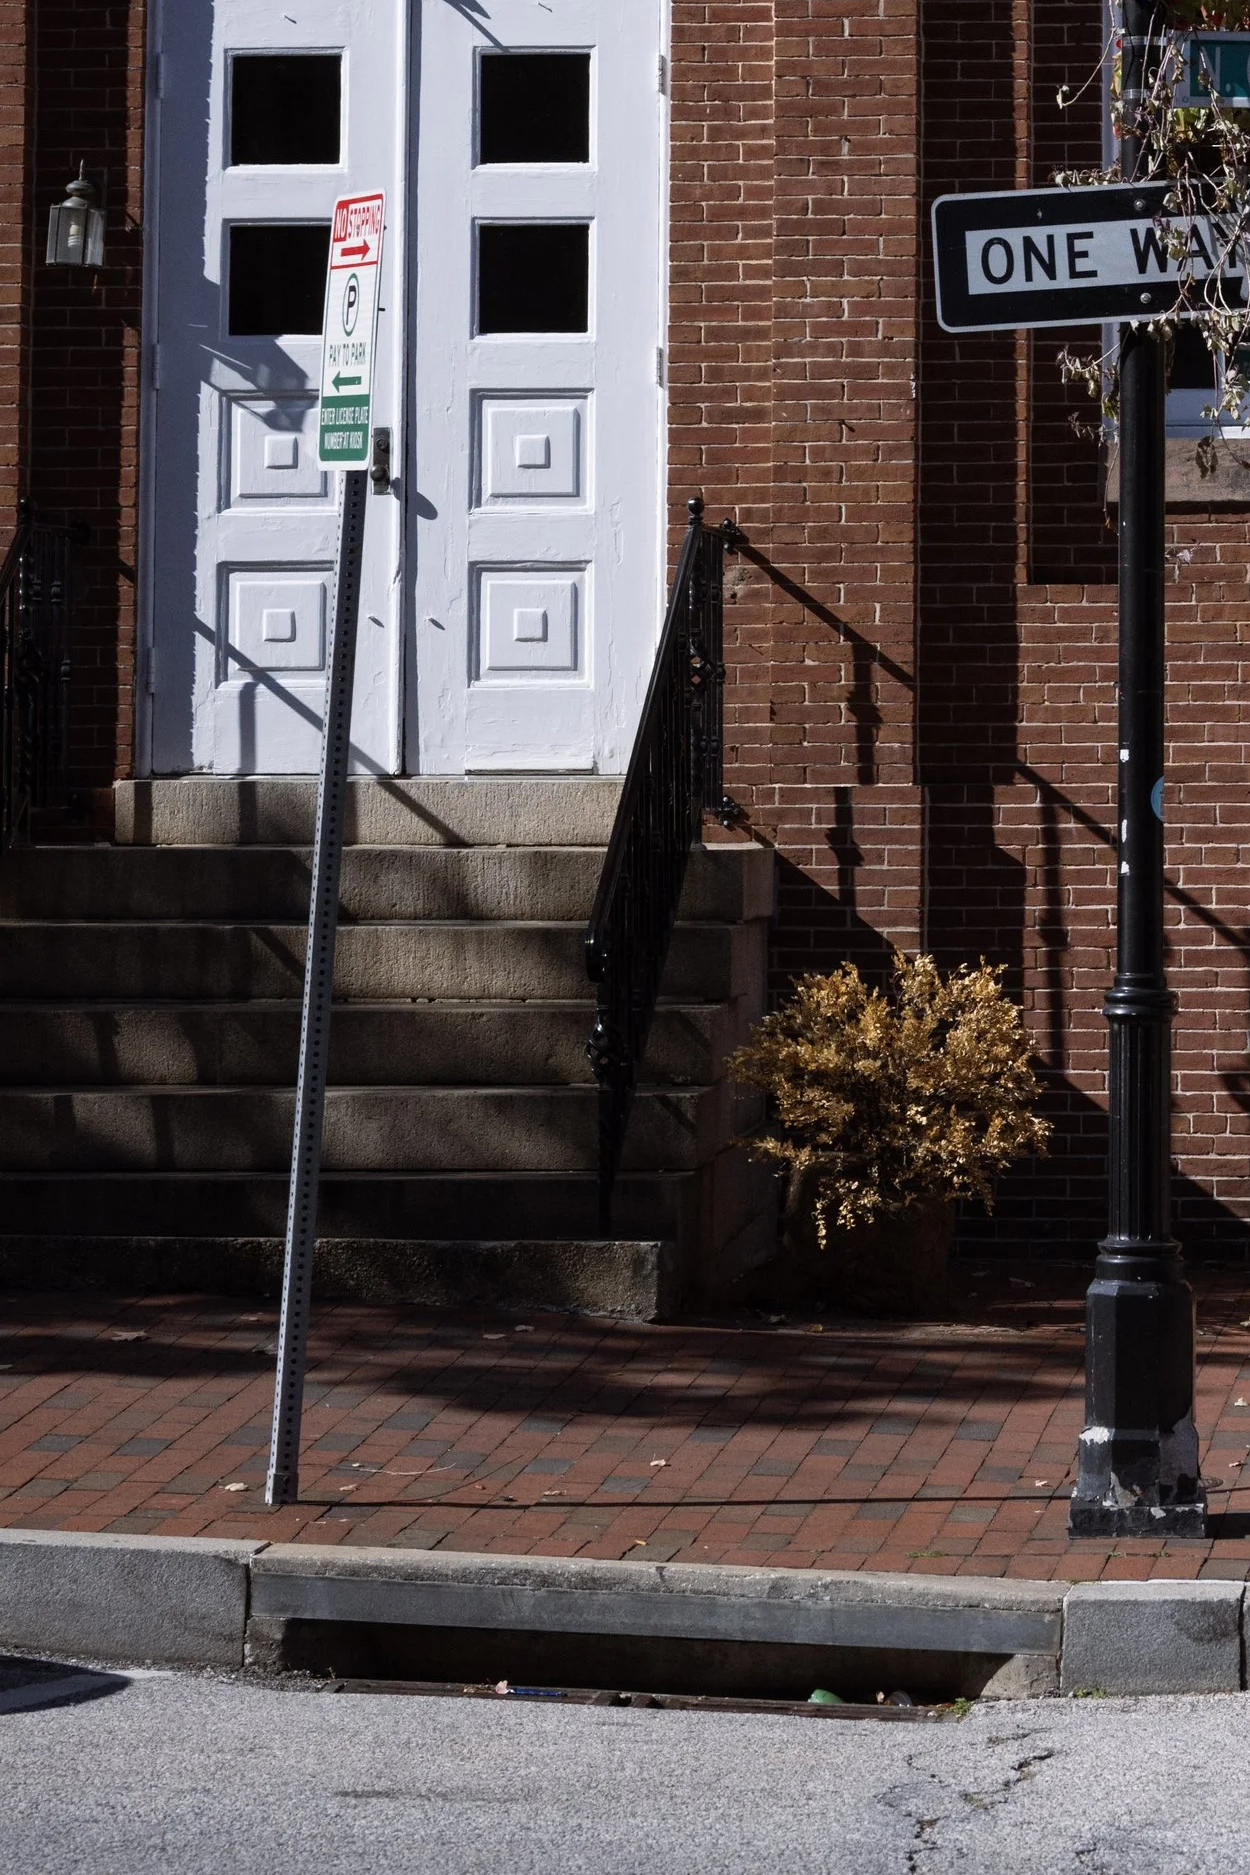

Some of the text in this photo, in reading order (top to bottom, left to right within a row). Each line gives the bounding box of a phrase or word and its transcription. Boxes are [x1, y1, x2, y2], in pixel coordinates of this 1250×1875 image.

[1199, 46, 1232, 93] N.
[334, 204, 381, 240] NO STOPPING
[980, 221, 1248, 285] ONE WAY
[345, 285, 357, 326] P
[328, 342, 367, 367] PAY TO PARK
[321, 406, 369, 426] ENTER LICENSE PLATE
[323, 431, 364, 450] NUMBER AT KIOSK
